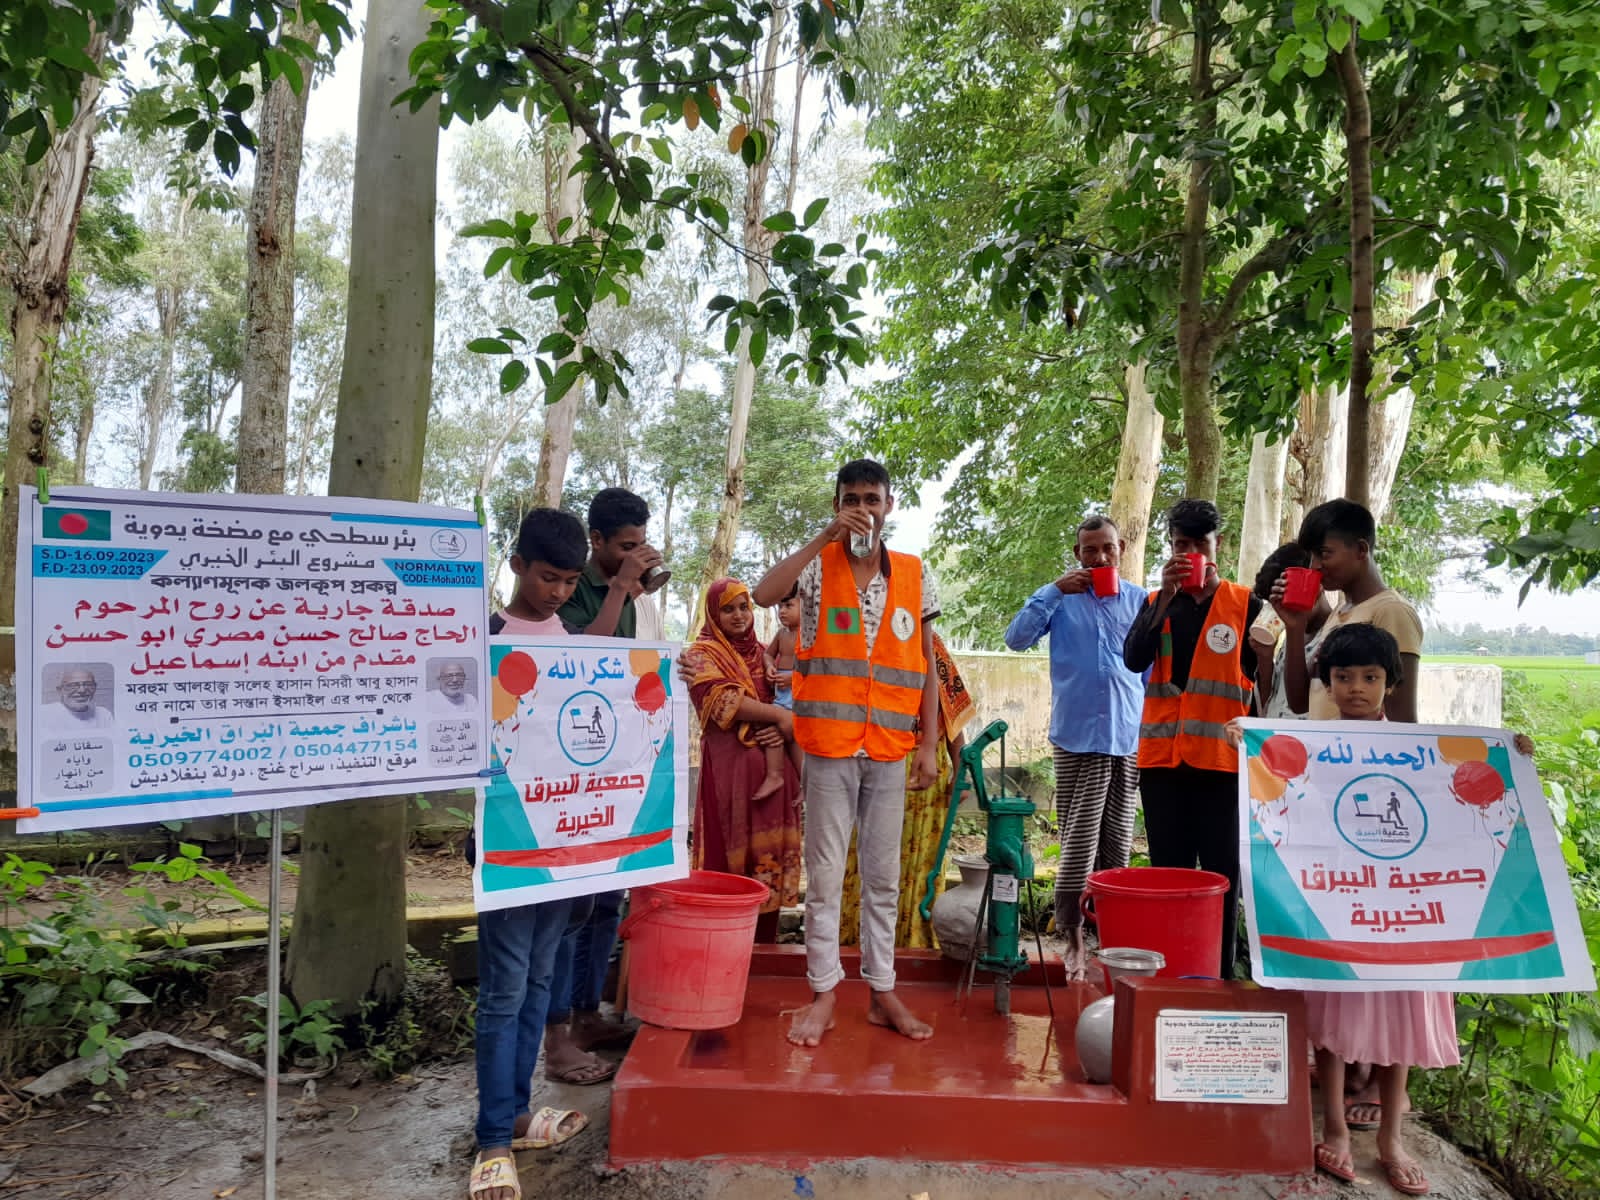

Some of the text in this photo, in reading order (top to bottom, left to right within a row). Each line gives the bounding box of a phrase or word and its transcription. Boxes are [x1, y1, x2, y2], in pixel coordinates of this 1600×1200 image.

[124, 514, 417, 551] بئر سطحي مع مضخة يدوية
[41, 548, 155, 563] S.D-16.09.2023
[179, 547, 375, 572] مشروع البئر الخيري
[394, 561, 476, 574] NORMAL TW
[41, 562, 144, 576] F.D-23.09.2023
[402, 573, 477, 586] CODE-Moha0102
[150, 574, 397, 596] কল্যাণমূলক জলকূপ প্রকল্প
[74, 596, 456, 621] صدقة جارية عن روح المرحوم
[46, 623, 477, 649] الحاج صالح حسن مصري ابو حسن
[130, 649, 417, 676] مقدم من ابنه إسماعيل
[547, 651, 625, 686] شكر الله
[125, 682, 169, 697] মরহুম
[275, 677, 313, 691] হাসান
[384, 675, 419, 689] হাসান
[135, 701, 160, 713] এর
[162, 699, 197, 713] নামে
[200, 698, 229, 711] তার
[330, 694, 350, 706] এর
[383, 691, 413, 705] থেকে
[128, 726, 211, 750] الخيرية
[289, 720, 346, 739] جمعية
[128, 745, 273, 769] 0509774002
[293, 738, 417, 758] 0504477154
[386, 752, 417, 773] موقع
[1317, 736, 1436, 772] الحمد لله
[130, 767, 207, 789] بنغلاديش
[211, 765, 246, 781] دولة
[289, 760, 325, 779] سراج
[524, 772, 645, 803] جمعية البيرق
[555, 805, 615, 838] الخيرية
[1300, 863, 1488, 895] جمعية البيرق
[1350, 901, 1446, 933] الخيرية
